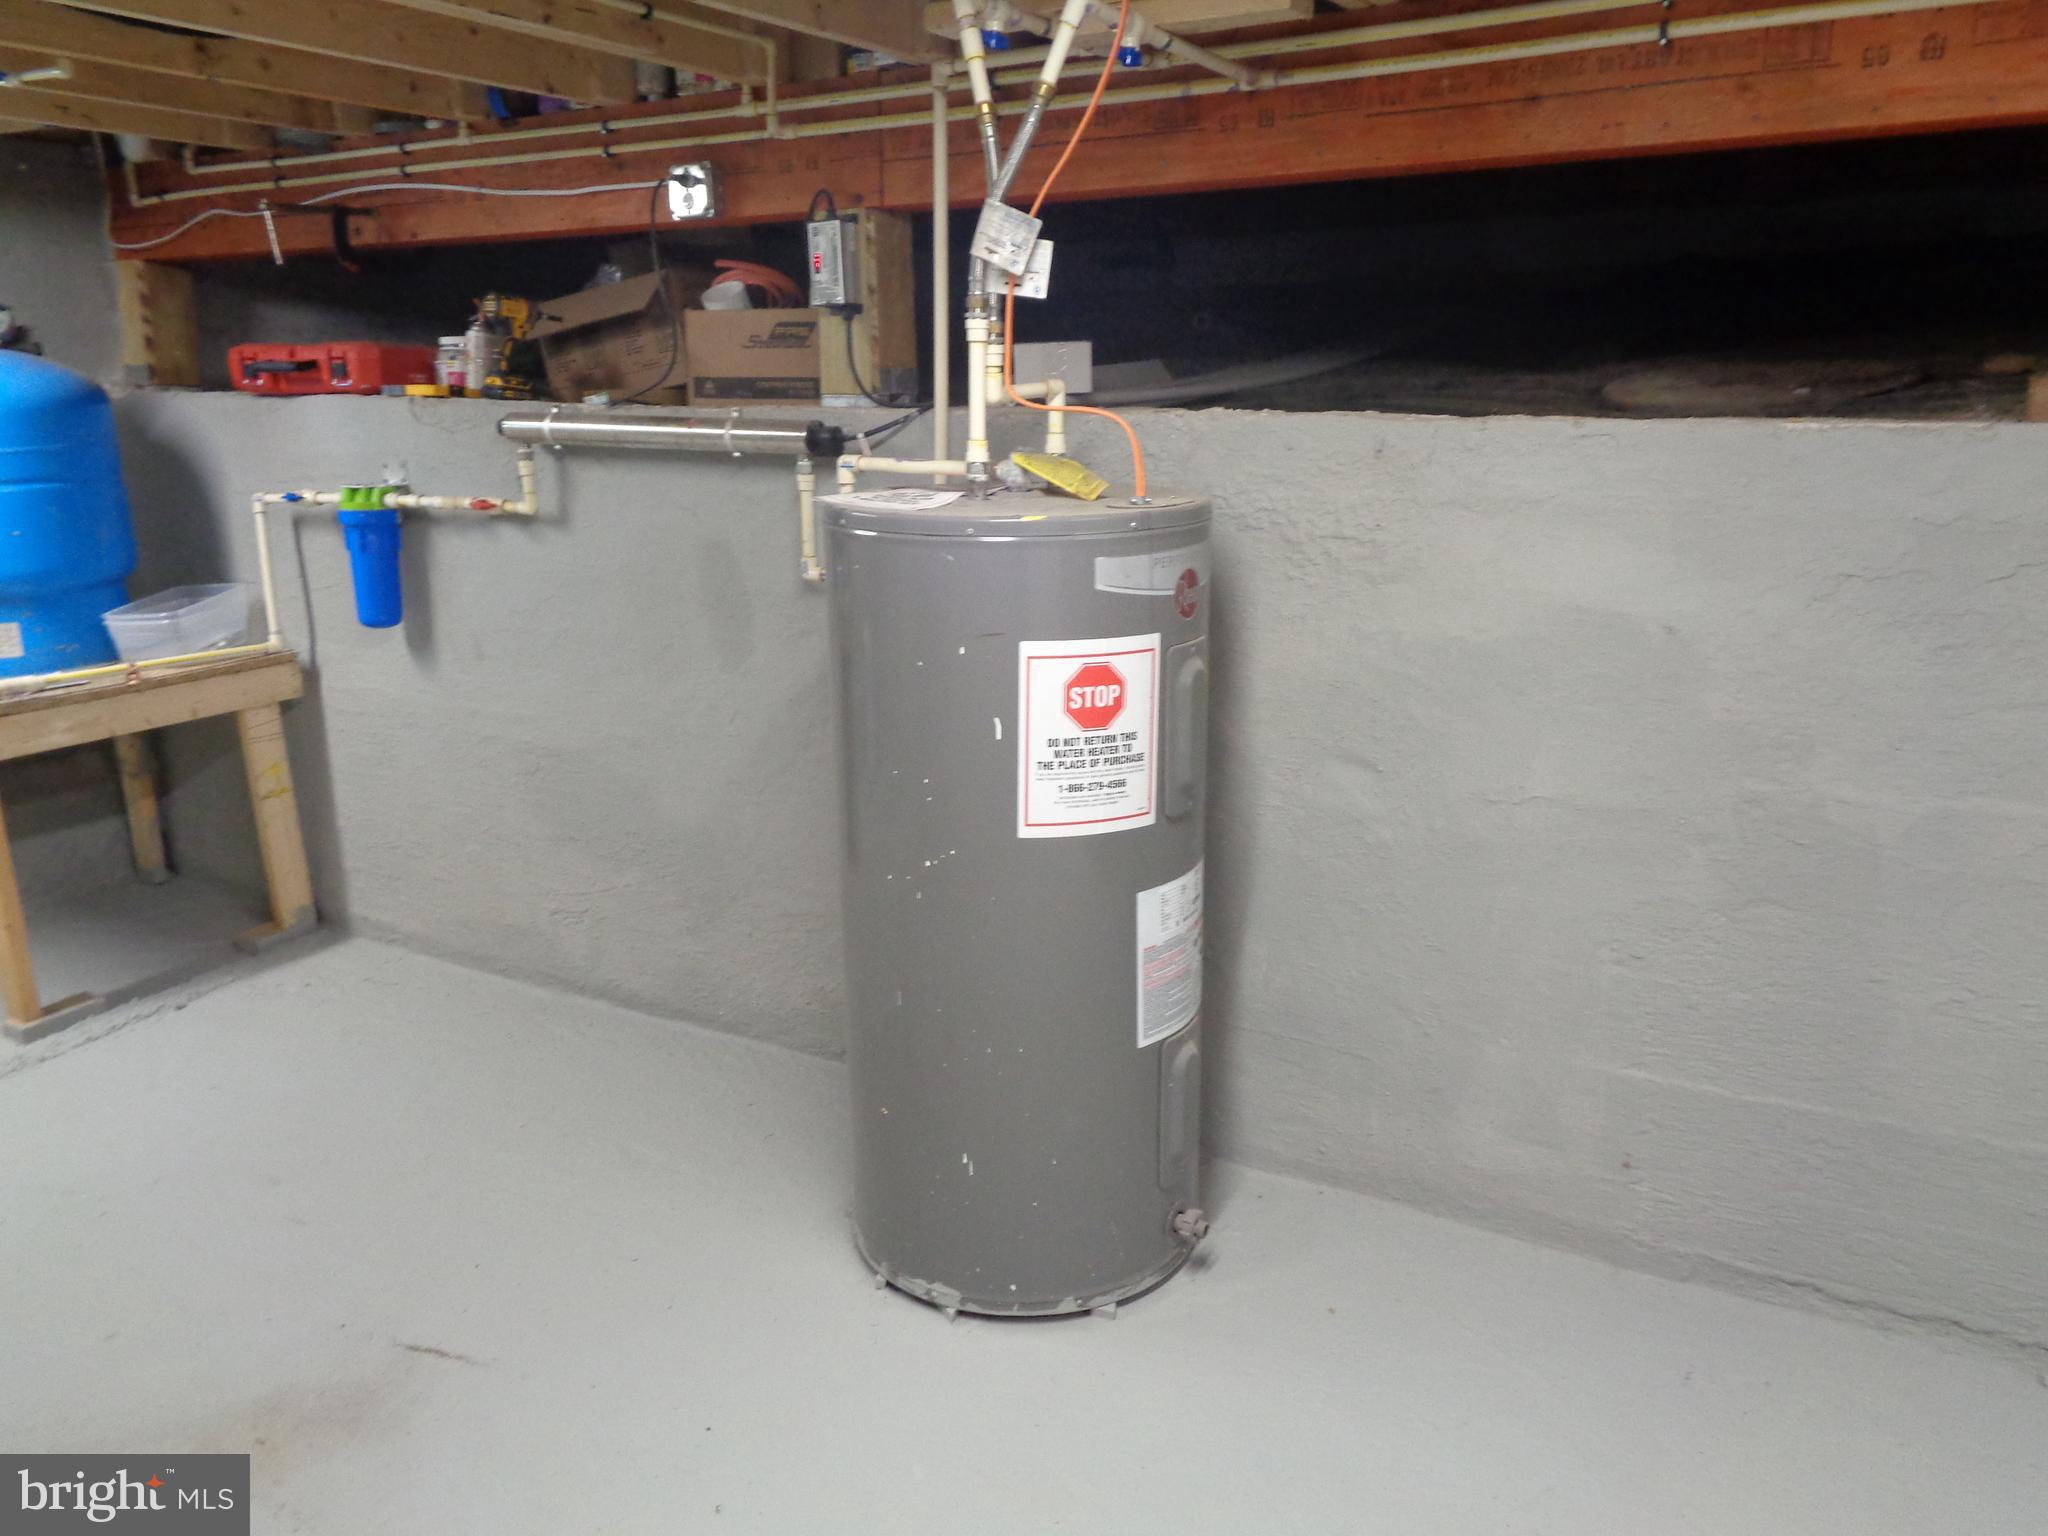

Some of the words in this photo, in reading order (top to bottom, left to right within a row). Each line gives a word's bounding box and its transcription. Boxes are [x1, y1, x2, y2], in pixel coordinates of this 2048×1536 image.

[1069, 684, 1121, 709] STOP
[1047, 737, 1060, 748] DO
[1064, 736, 1081, 747] NOT
[1084, 734, 1117, 746] RETURN
[1120, 732, 1138, 742] THIS
[1054, 748, 1084, 759] WATER
[1088, 746, 1120, 757] HEATER
[1122, 744, 1133, 754] TO
[1037, 761, 1054, 771] THE
[1058, 758, 1087, 770] PLACE
[1090, 757, 1101, 768] OF
[1104, 752, 1146, 766] PURCHASE
